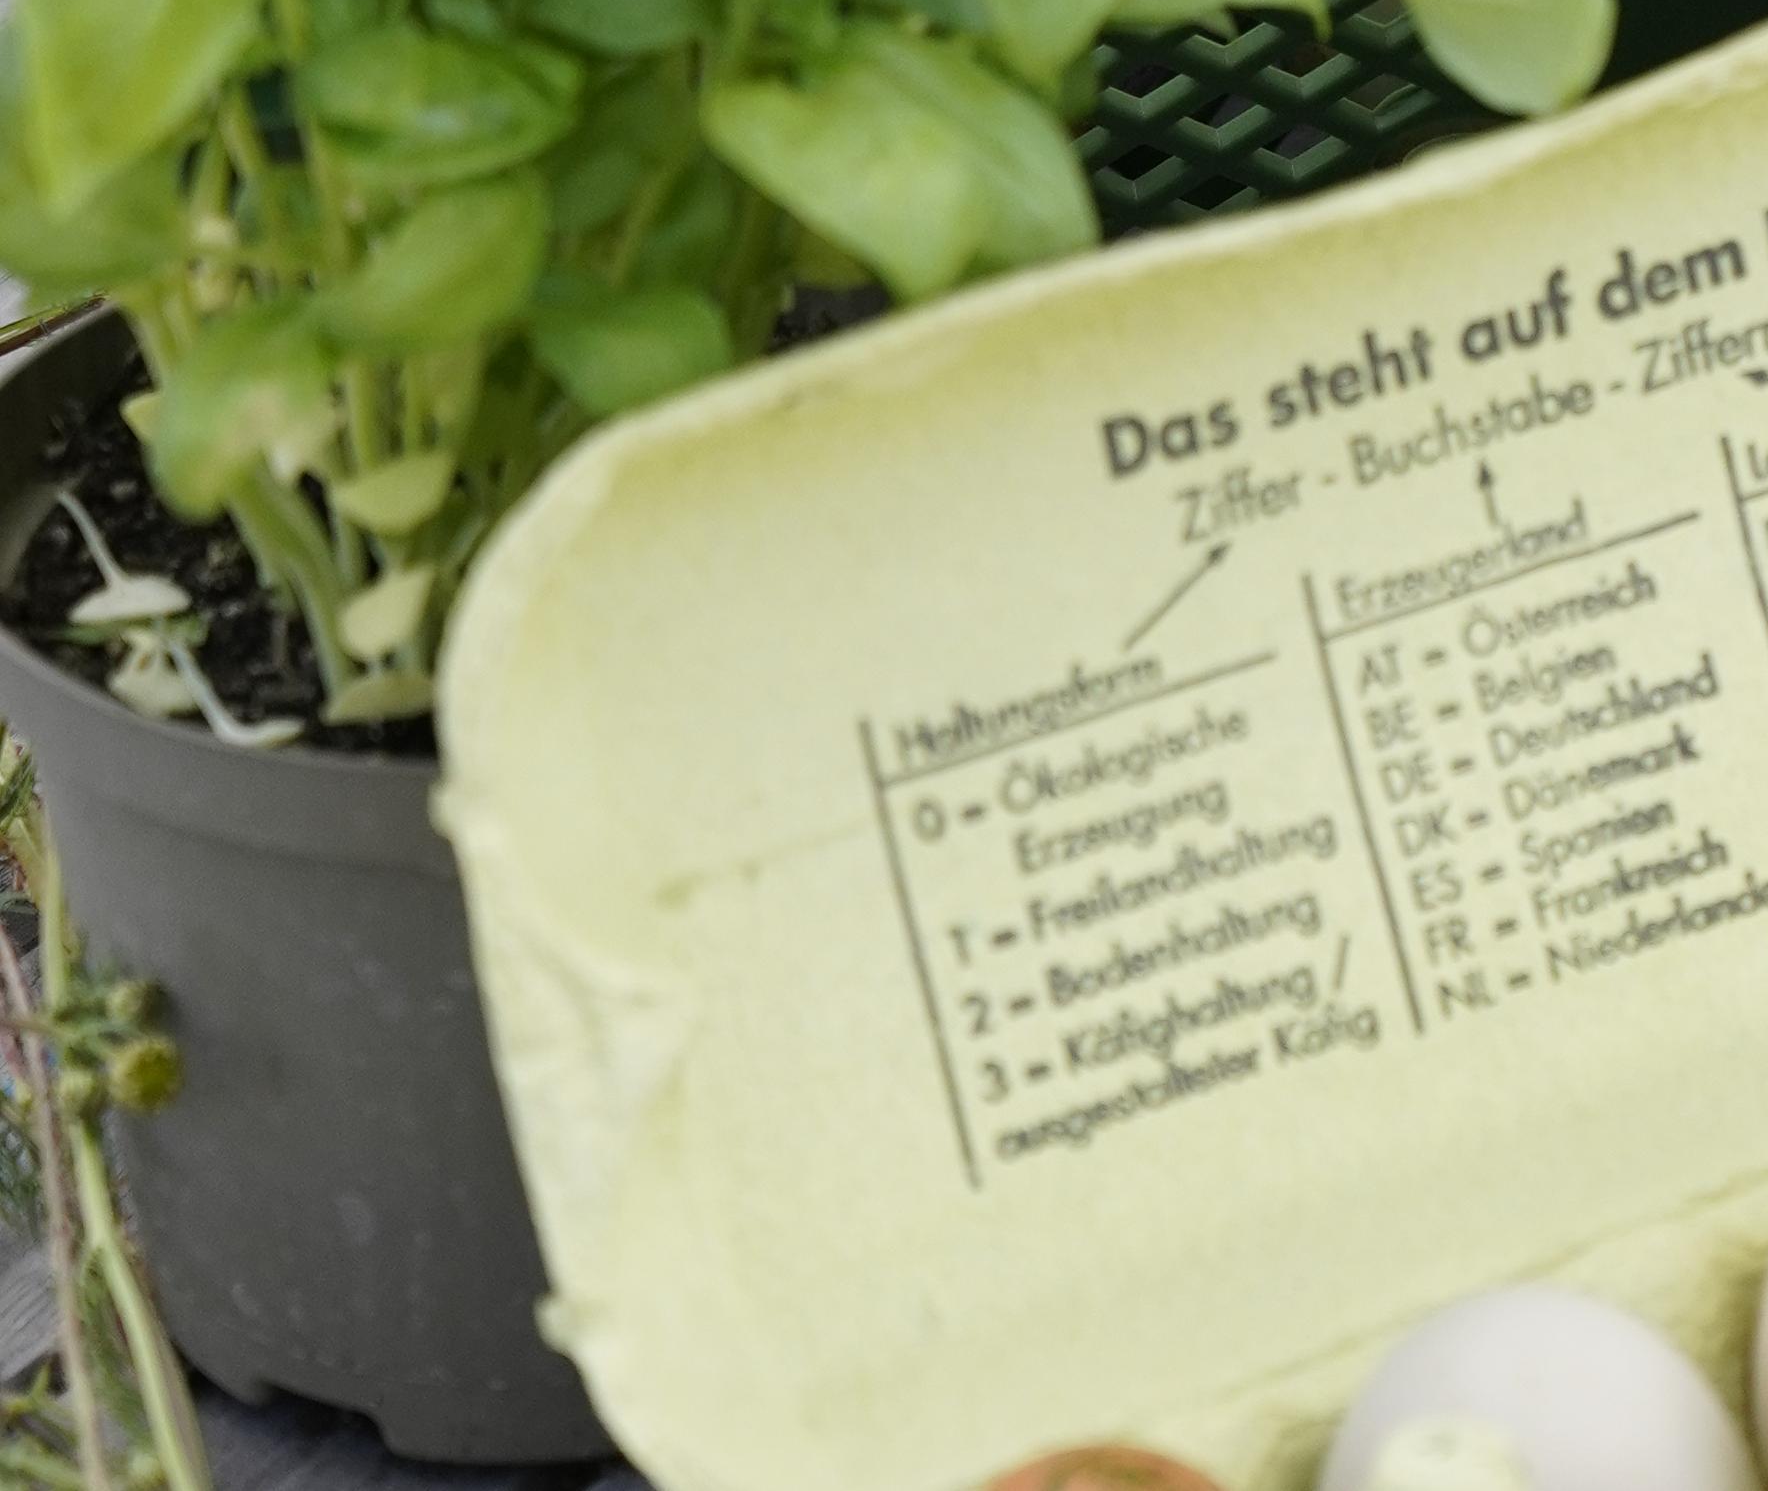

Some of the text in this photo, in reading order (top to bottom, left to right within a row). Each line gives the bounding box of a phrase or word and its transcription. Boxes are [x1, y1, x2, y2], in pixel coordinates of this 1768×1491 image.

[1102, 401, 1240, 480] Das
[1268, 330, 1436, 431] steht
[1459, 269, 1575, 364] auf
[1594, 237, 1747, 322] dem
[1175, 469, 1305, 545] Ziffer
[1347, 373, 1597, 488] Buchstabe
[1335, 495, 1590, 617] Erzeugerland
[1359, 643, 1401, 695] AT
[1461, 559, 1659, 657] Österreich
[1364, 700, 1420, 750] BE
[1473, 646, 1616, 713] Belgien
[1378, 753, 1437, 806] DE
[1488, 650, 1720, 769] Deutschland
[1393, 804, 1458, 859] DK
[1410, 861, 1464, 912] ES
[1422, 914, 1474, 966] FR
[1530, 826, 1730, 929] Frankreich
[960, 992, 993, 1039] 2
[979, 1060, 1010, 1105] 3
